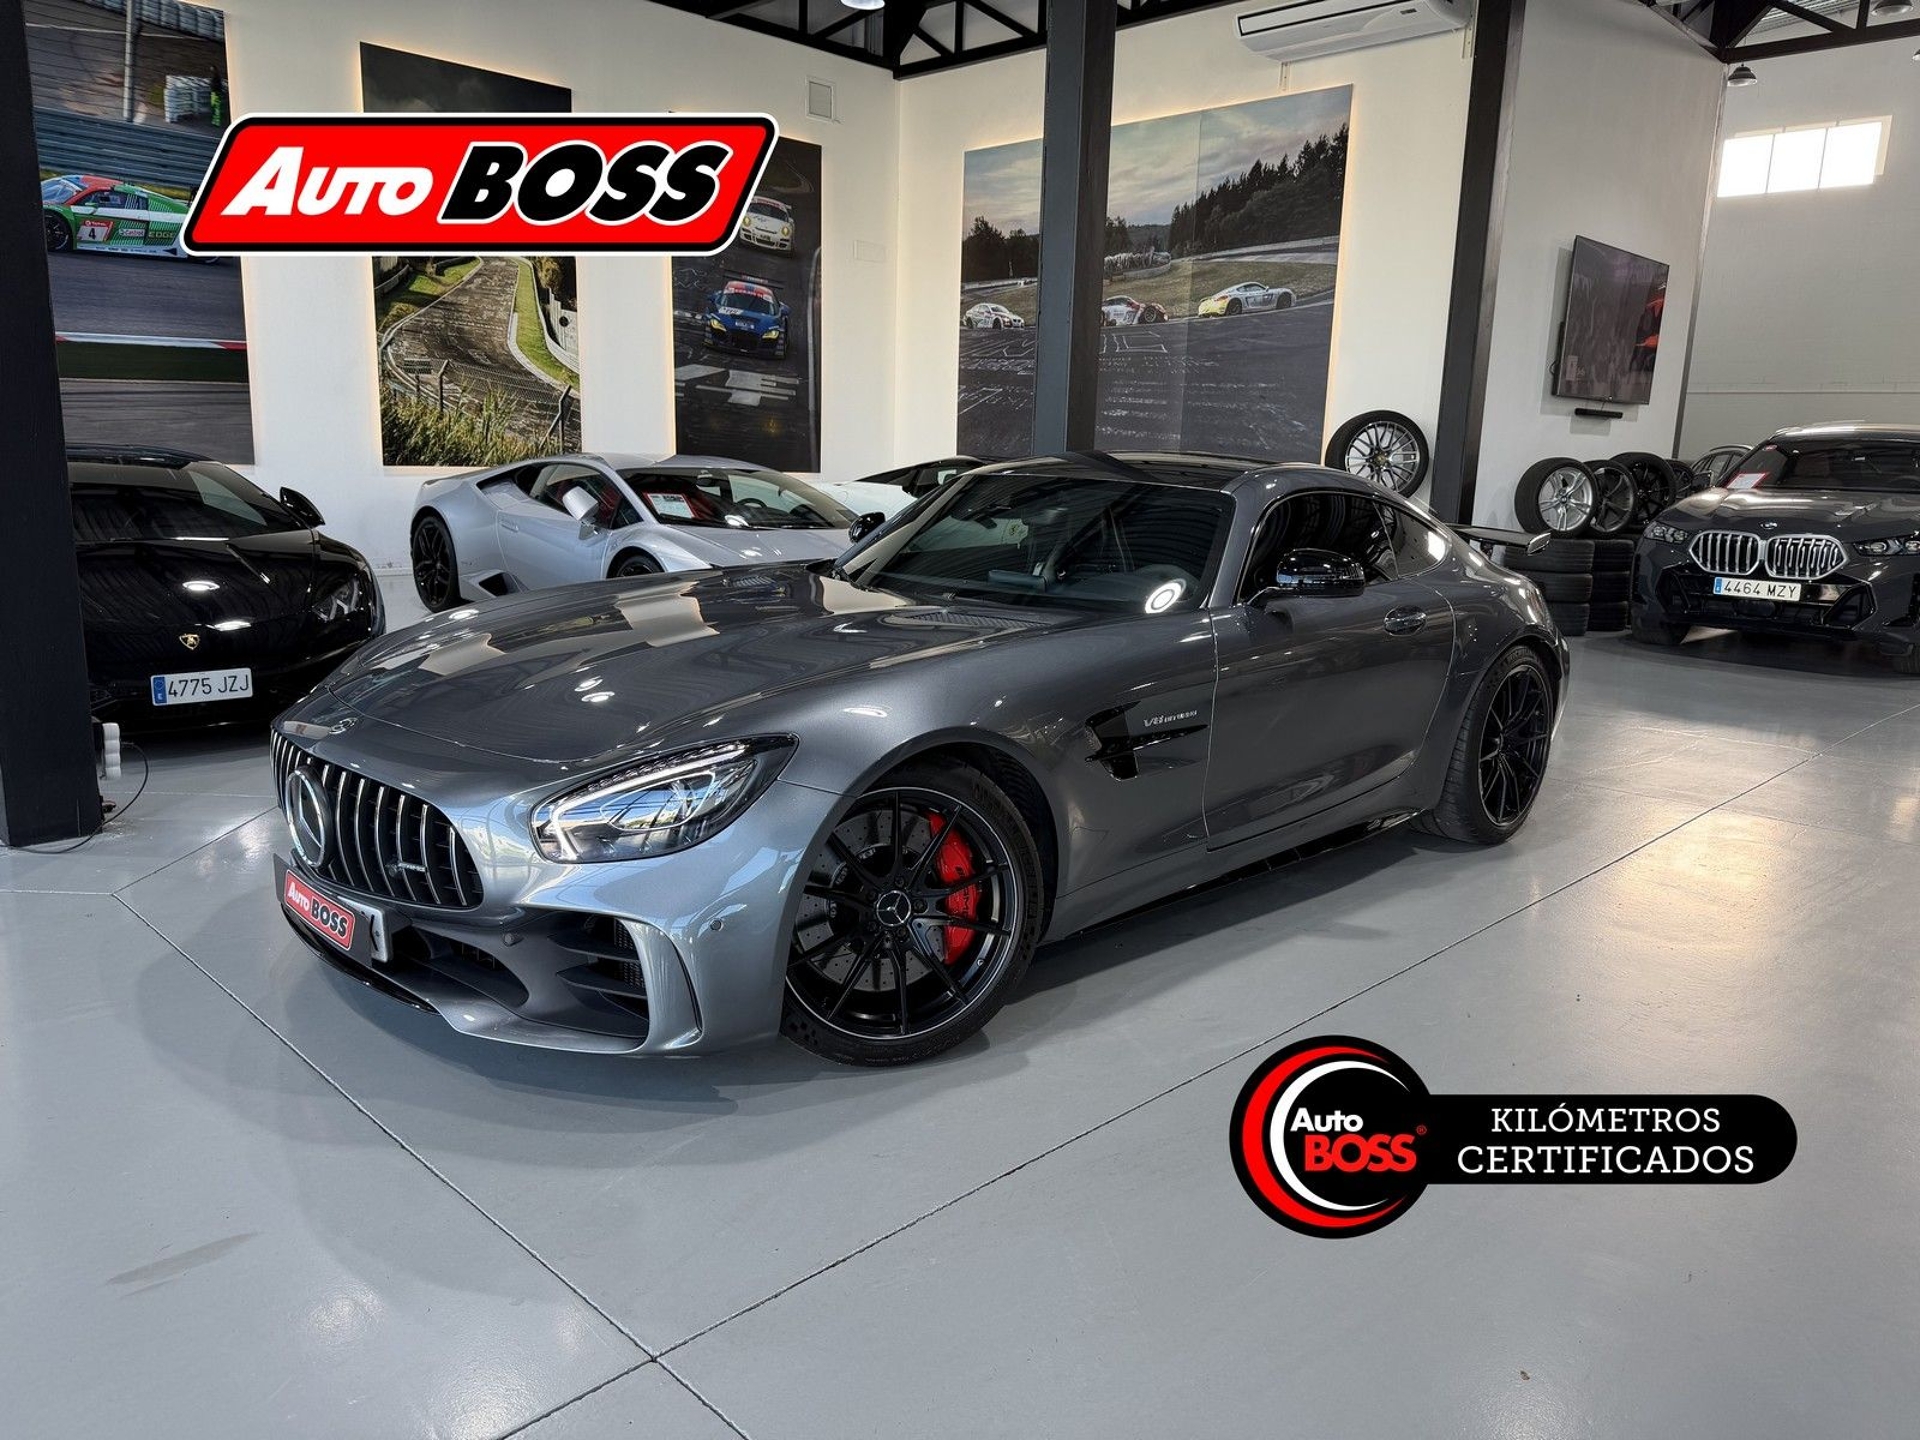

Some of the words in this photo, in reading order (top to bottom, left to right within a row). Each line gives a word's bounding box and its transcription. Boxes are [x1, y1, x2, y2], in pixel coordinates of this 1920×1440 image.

[88, 227, 96, 240] 4
[1724, 581, 1761, 595] 4464
[1767, 584, 1797, 598] MZY
[168, 678, 212, 697] 4775
[218, 674, 249, 693] JZJ
[311, 896, 348, 939] BOSS
